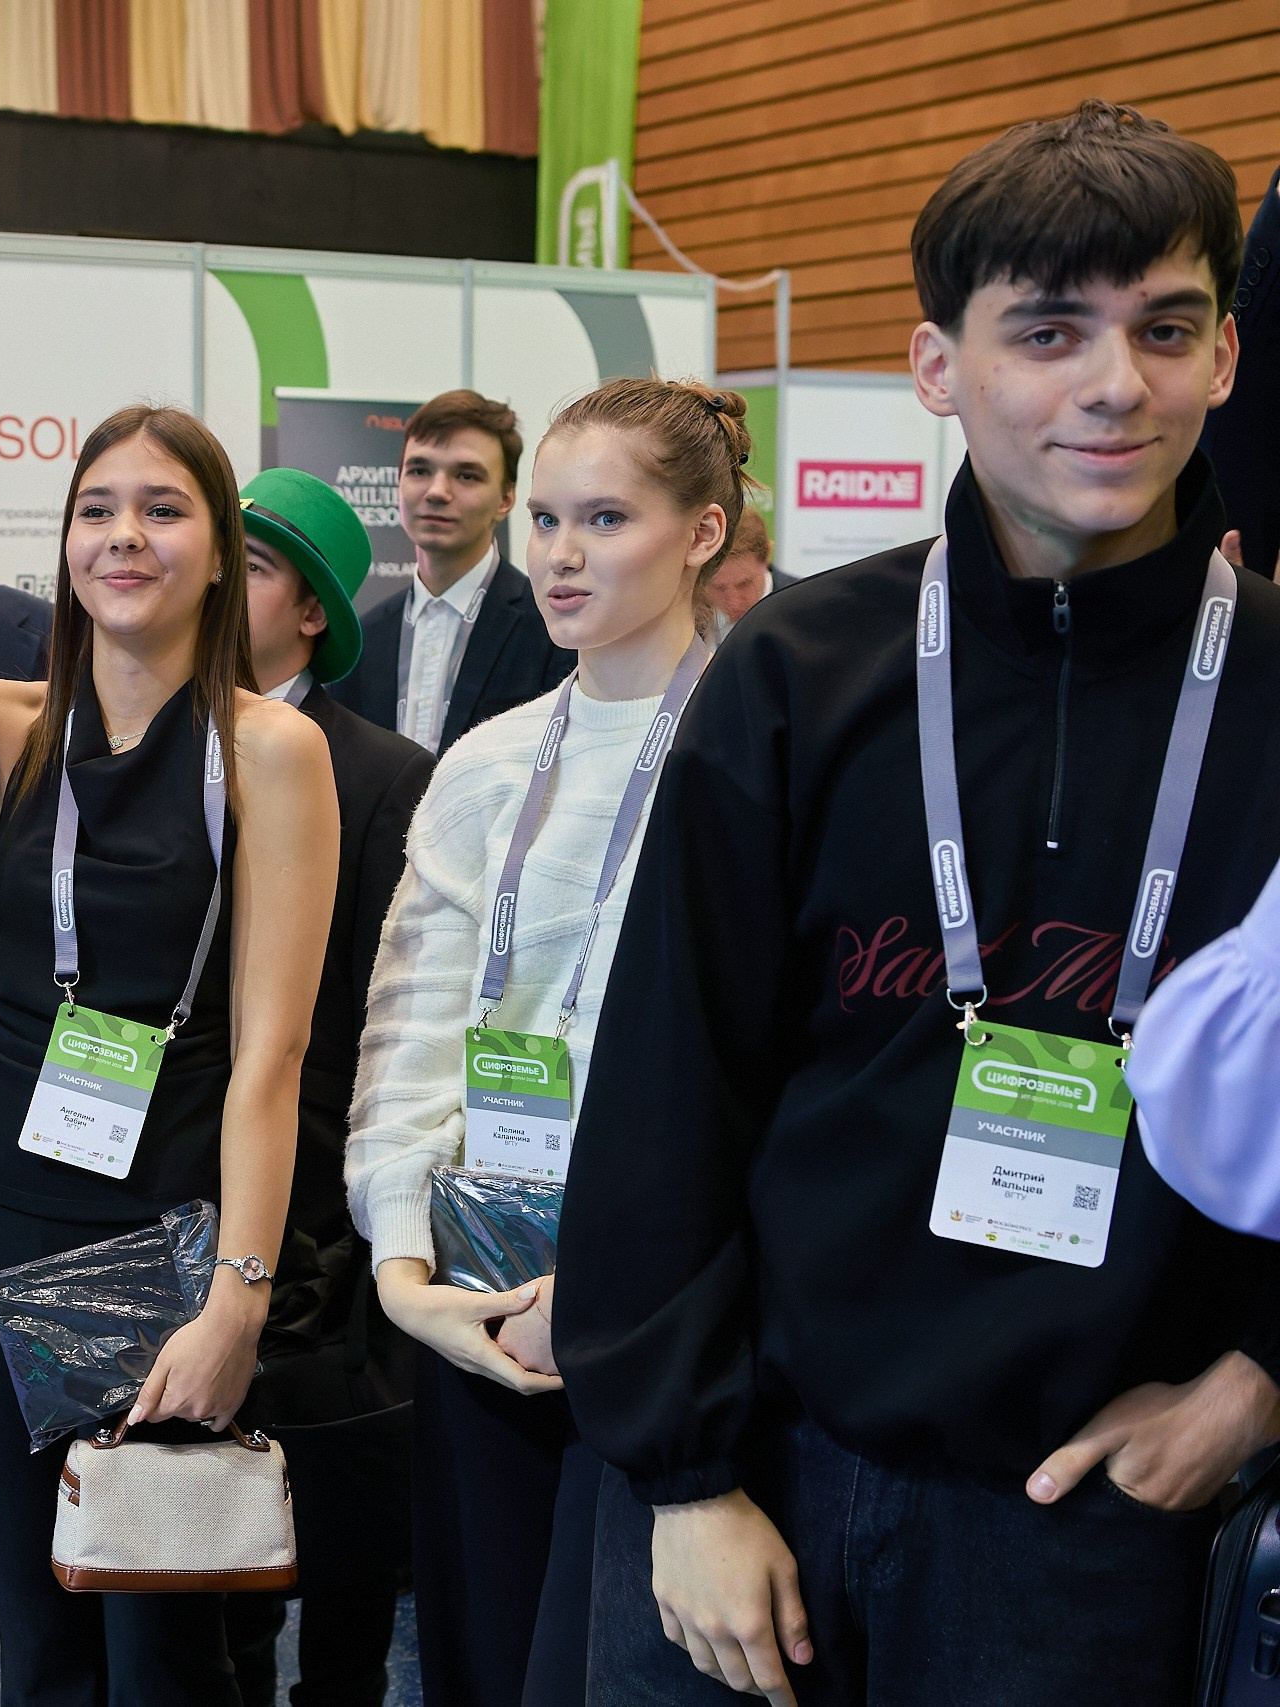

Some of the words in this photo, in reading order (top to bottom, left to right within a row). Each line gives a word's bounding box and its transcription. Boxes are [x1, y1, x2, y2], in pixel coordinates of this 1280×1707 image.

[67, 1039, 129, 1063] ЦИФРОЗЕМЬЕ
[481, 1061, 540, 1076] ЦИФРОЗЕМЬЕ
[58, 1072, 103, 1092] УЧАСТНИК
[985, 1071, 1084, 1100] ЦИФРОЗЕМЬЕ
[482, 1095, 525, 1108] УЧАСТНИК
[60, 1106, 95, 1123] Ангелина
[63, 1114, 87, 1128] Бабич
[498, 1125, 525, 1136] Полина
[977, 1120, 1047, 1144] УЧАСТНИК
[992, 1165, 1045, 1183] Дмитрий
[991, 1177, 1043, 1195] Мальцев
[1004, 1190, 1027, 1201] ВГТУ
